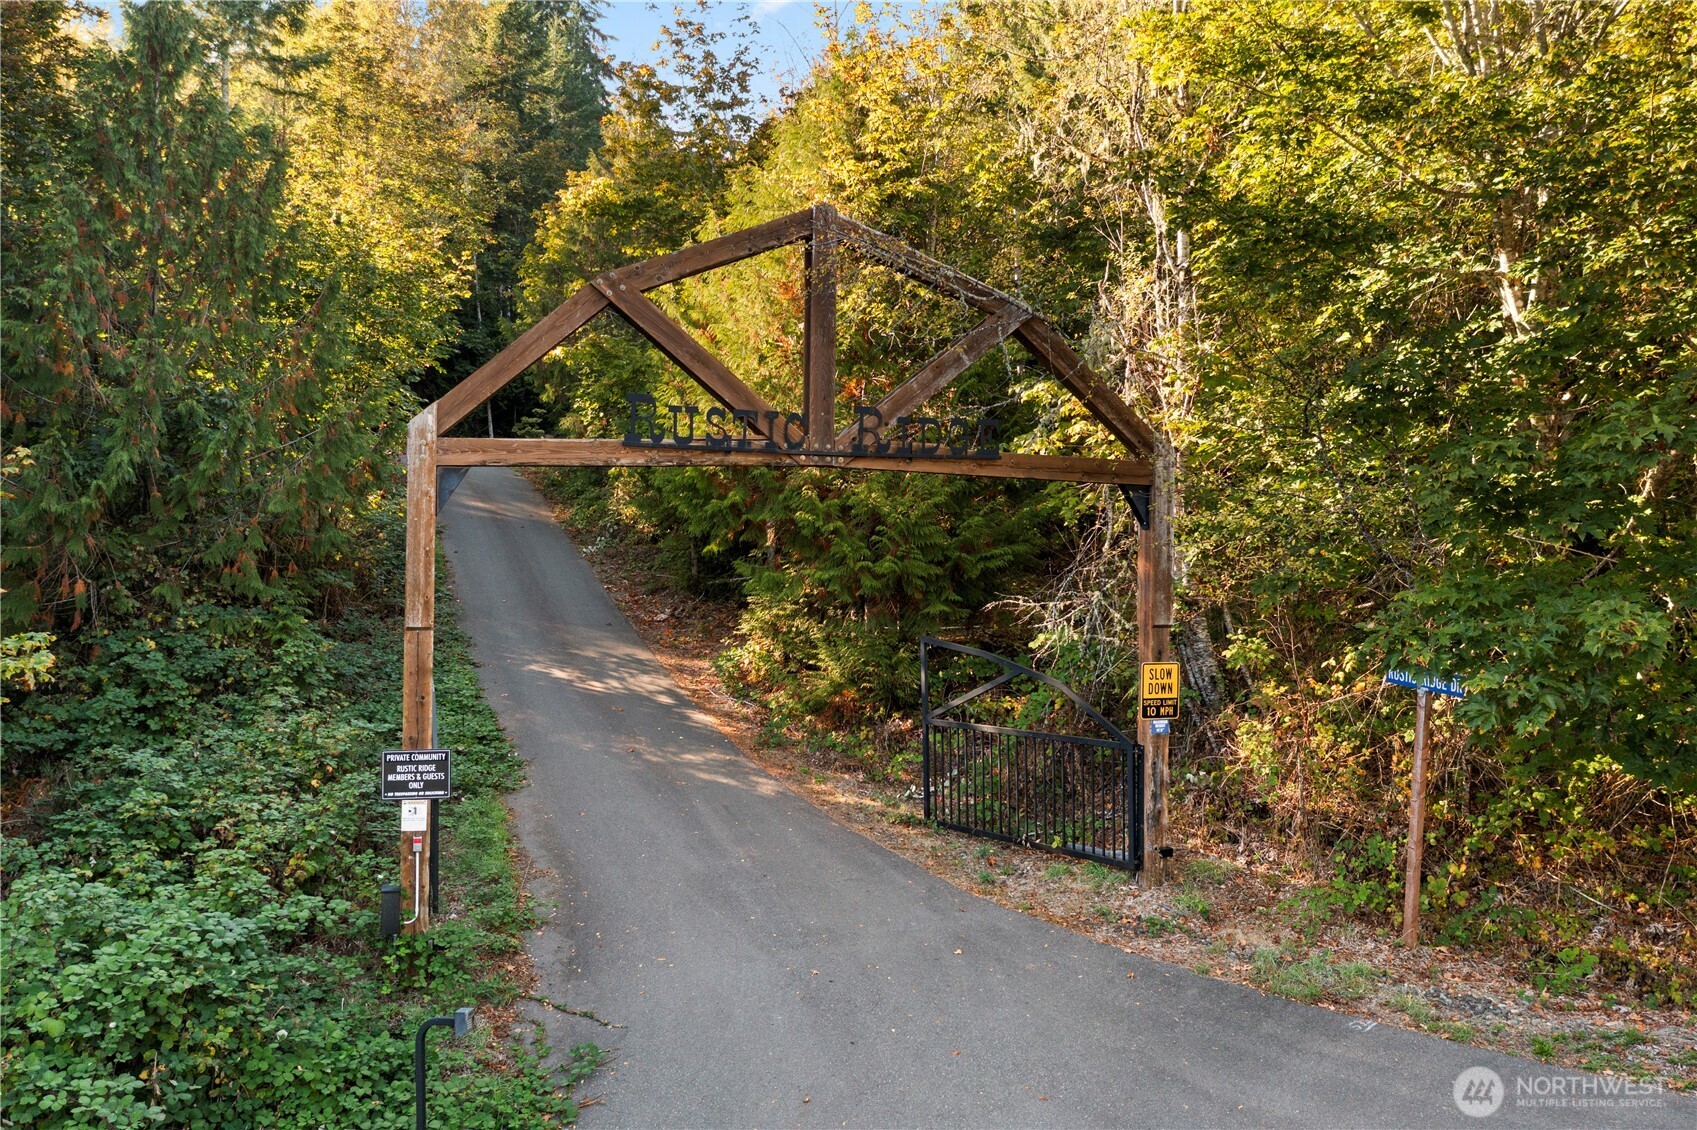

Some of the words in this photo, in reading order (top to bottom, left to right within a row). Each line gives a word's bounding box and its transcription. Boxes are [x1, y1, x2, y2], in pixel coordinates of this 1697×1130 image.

[624, 393, 806, 450] RUSTIC
[852, 406, 1000, 457] RIDGE
[1149, 668, 1173, 680] SLOW
[1148, 682, 1173, 695] DOWN
[1147, 707, 1156, 716] 10
[1160, 706, 1174, 716] MPH
[386, 754, 410, 762] PRIVATE
[411, 753, 446, 761] COMMUNITY
[418, 764, 436, 772] RIDGE
[387, 773, 415, 781] MEMBERS
[416, 773, 421, 781] &
[422, 772, 445, 780] GUESTS
